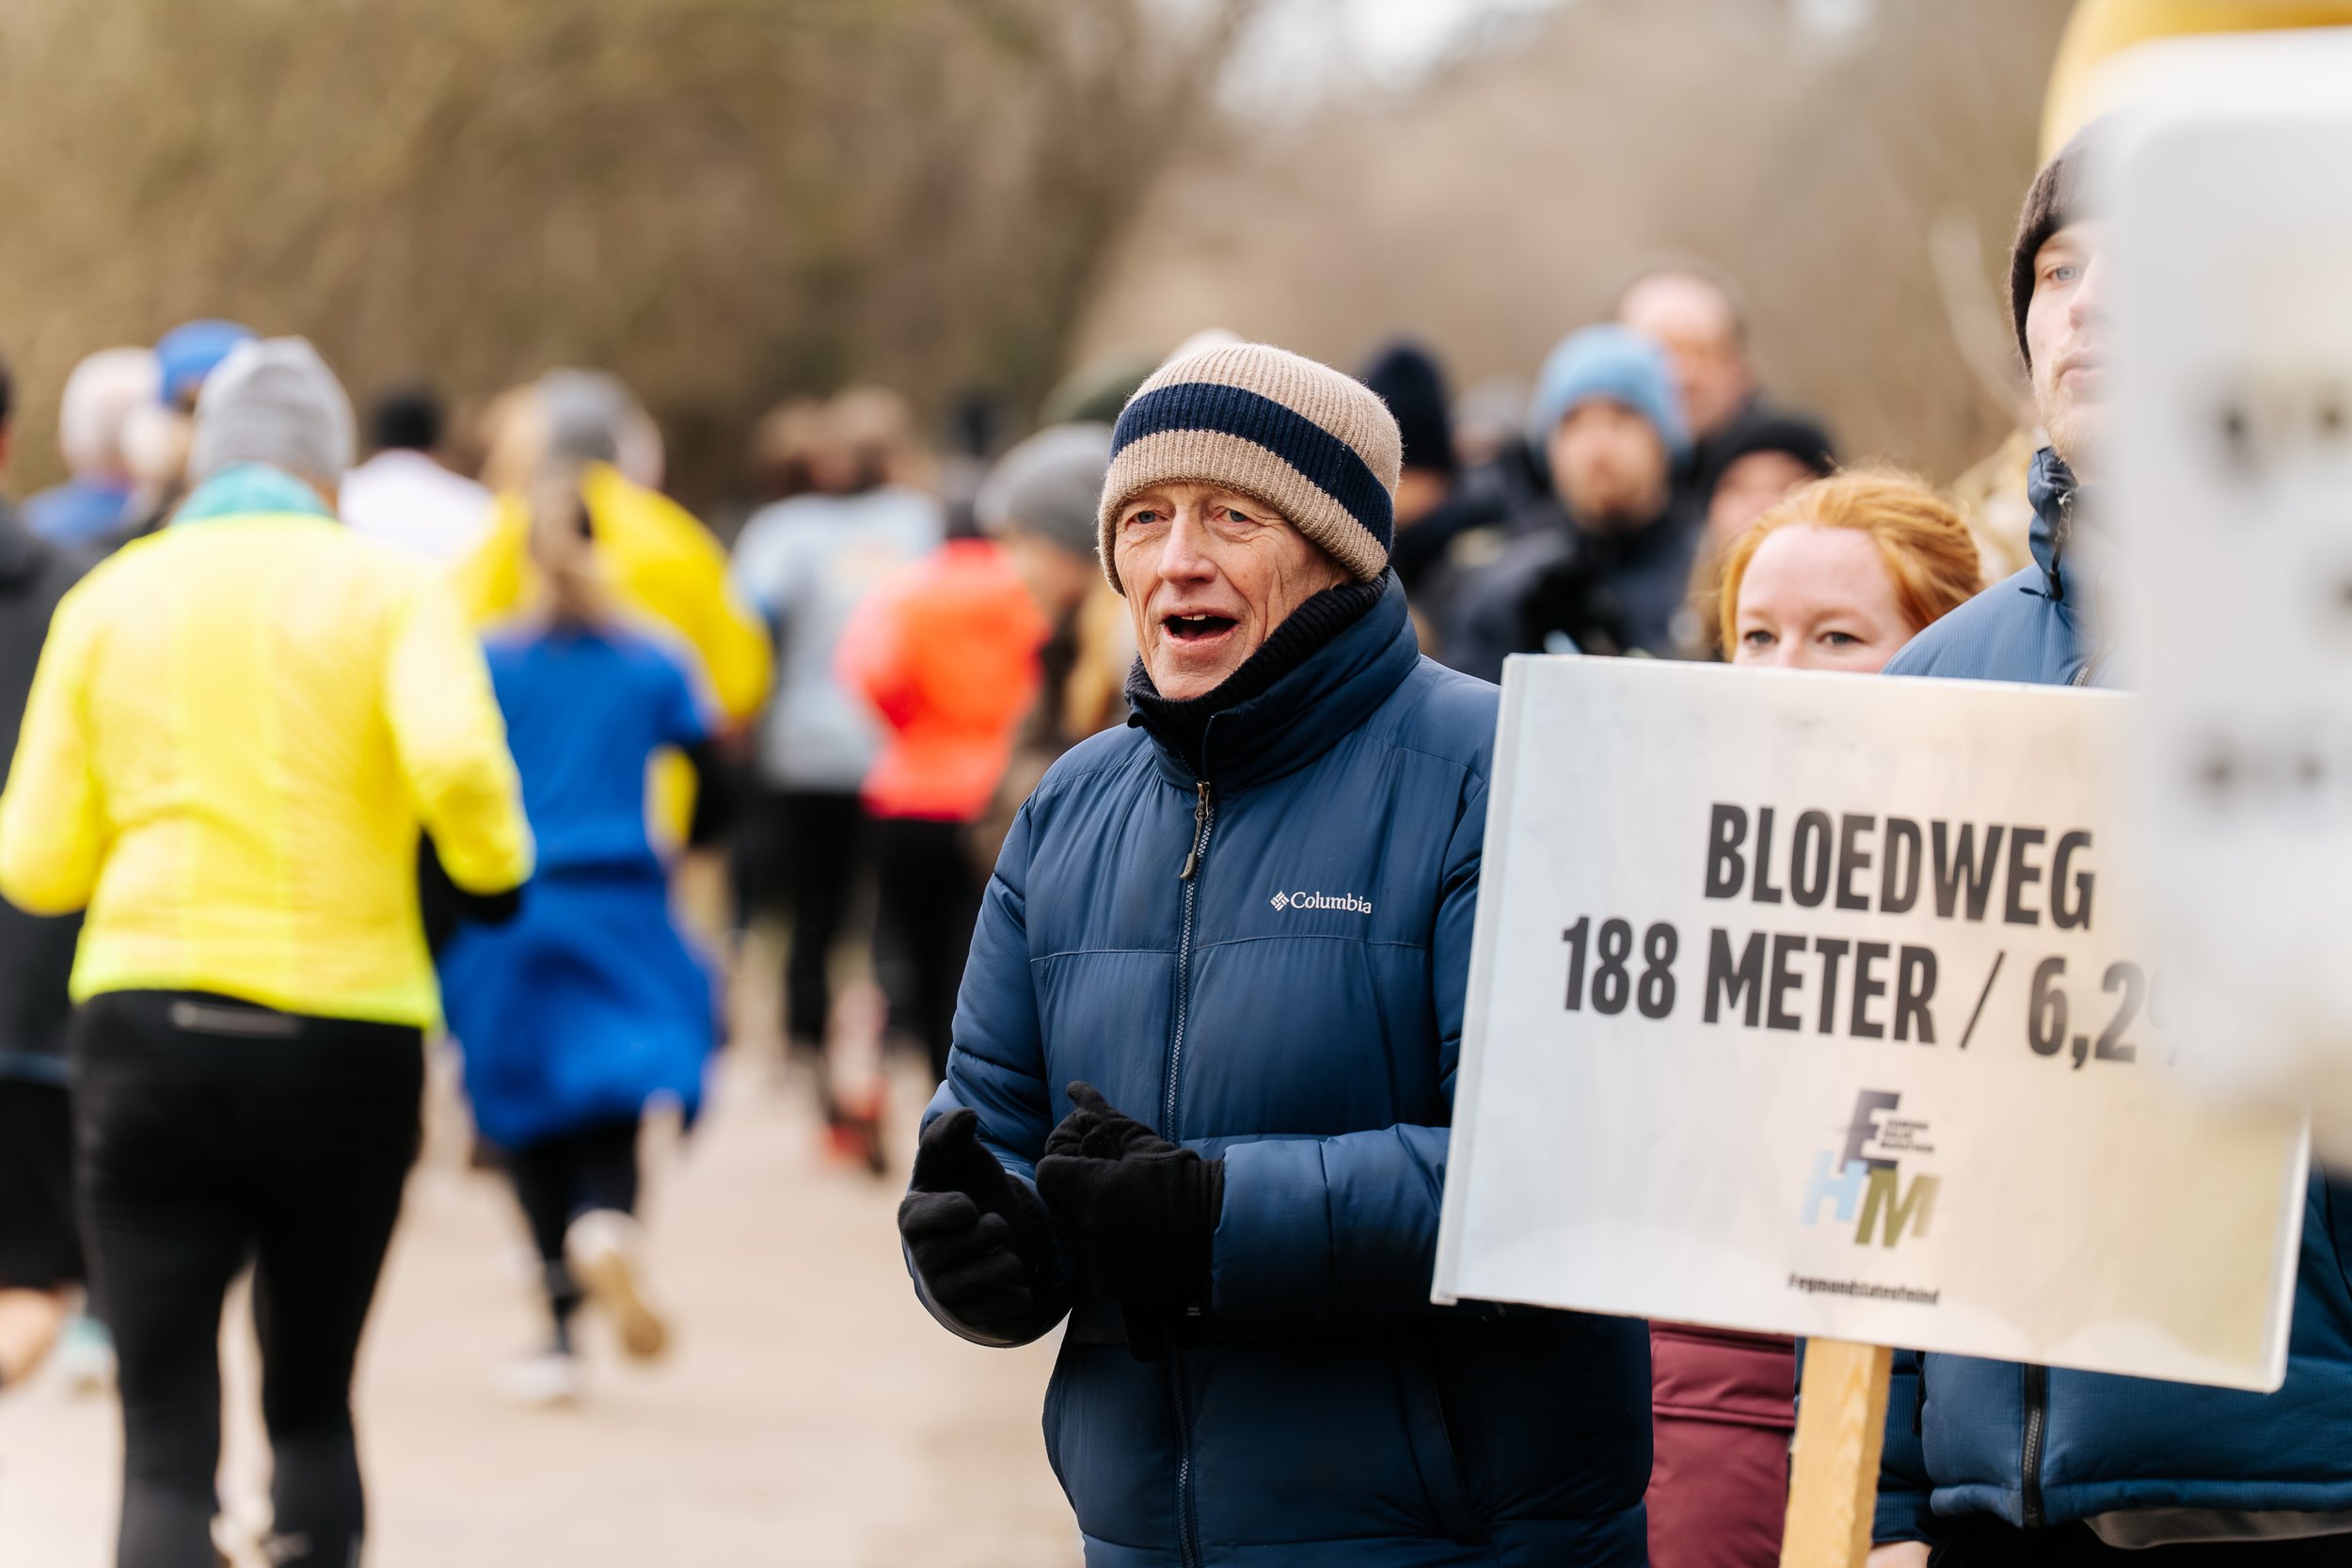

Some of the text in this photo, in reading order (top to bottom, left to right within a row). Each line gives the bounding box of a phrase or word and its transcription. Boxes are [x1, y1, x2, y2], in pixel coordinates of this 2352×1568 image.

[1290, 891, 1372, 914] Columbia
[1704, 802, 2095, 931] BLOEDWEG
[1562, 915, 2181, 1072] 188 METER / 6,2
